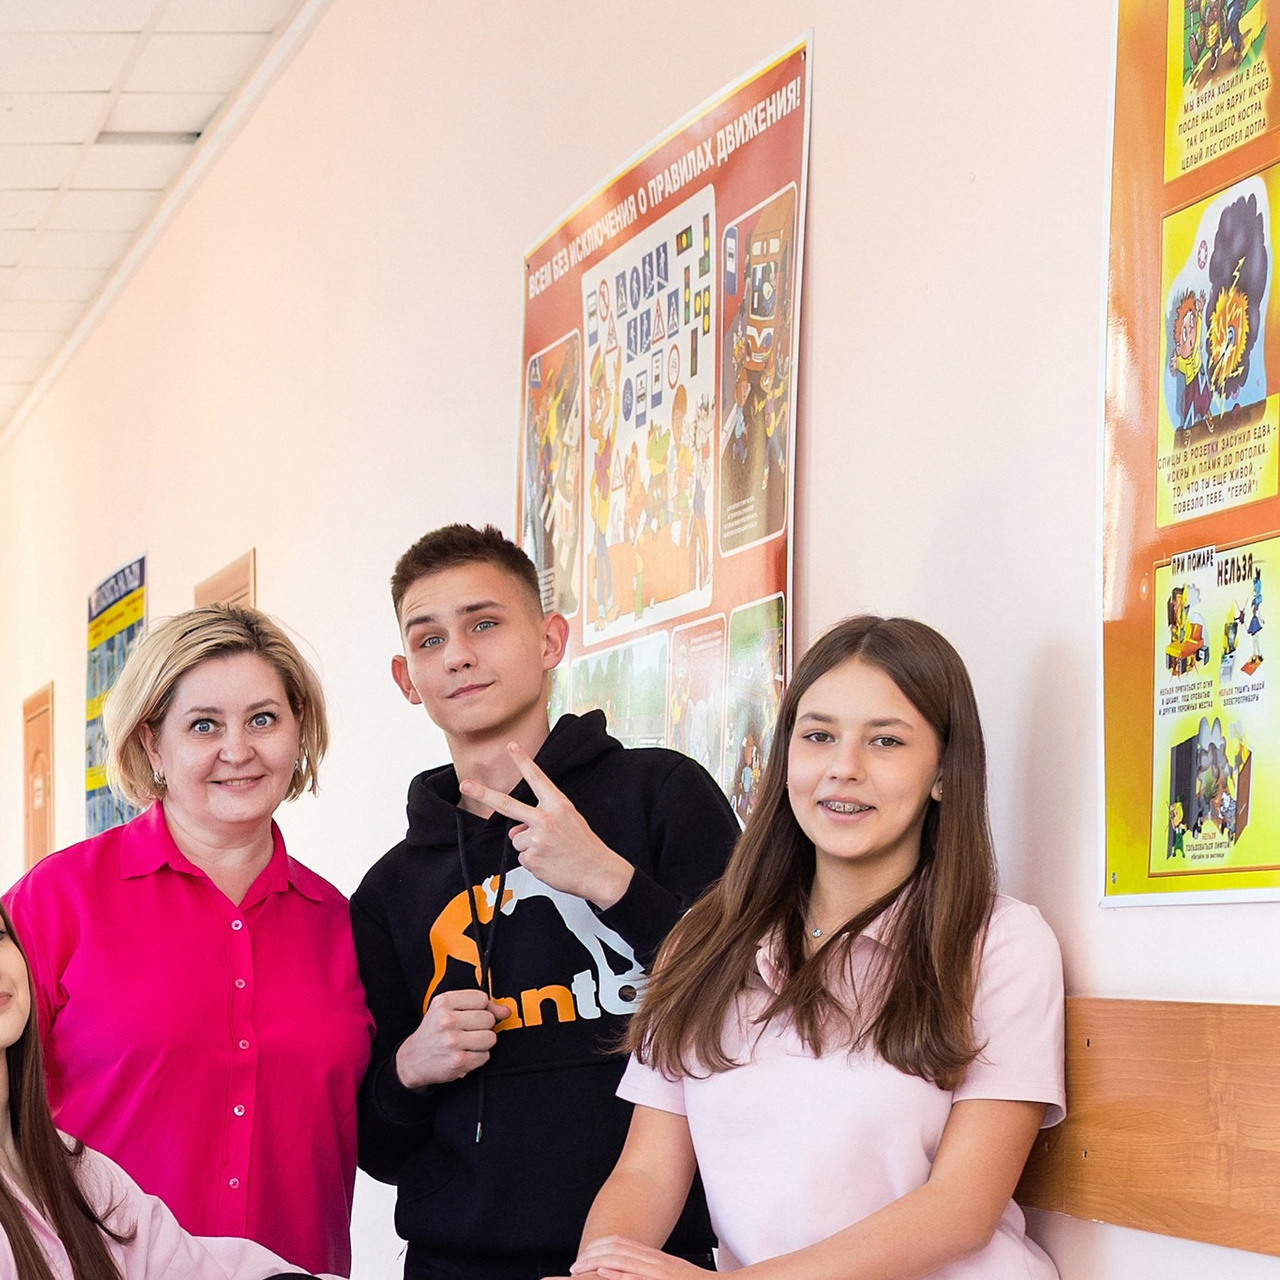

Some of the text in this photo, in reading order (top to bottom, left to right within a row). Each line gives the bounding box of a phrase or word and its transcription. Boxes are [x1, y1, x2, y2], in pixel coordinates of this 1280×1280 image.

[1184, 61, 1266, 114] МЫ ВЧЕРА ХОДИЛИ В ЛЕС,
[1179, 116, 1199, 136] ПОСЛЕ
[1201, 109, 1213, 125] НАС
[1216, 102, 1225, 116] ОН
[1227, 91, 1247, 110] ВДРУГ
[1186, 102, 1262, 149] ТАК ОТ НАШЕГО КОСТРА
[1182, 118, 1266, 170] ЦЕЛЫЙ ЛЕС СГОРЕЛ ДОТЛА
[529, 76, 801, 300] ВСЕМ БЕЗ ИСКЛЮЧЕНИЯ О ПРАВИЛАХ ДВИЖЕНИЯ!
[1158, 453, 1180, 469] СПИЦЫ
[1184, 451, 1187, 461] В
[1191, 441, 1219, 460] РОЗЕТКУ
[1254, 424, 1270, 439] ЕДВА
[1167, 465, 1189, 483] ИСКРЫ
[1192, 465, 1196, 476] И
[1199, 457, 1220, 473] ПЛАМЯ
[1224, 454, 1232, 468] ДО
[1173, 496, 1203, 514] ПОВЕЗЛО
[1187, 481, 1199, 494] ЧТО
[1202, 477, 1209, 490] ТЫ
[1213, 472, 1226, 486] ЕЩЕ
[1172, 548, 1213, 576] ПРИ ПОЖАРЕ
[1217, 553, 1253, 587] НЕЛЬЗЯ
